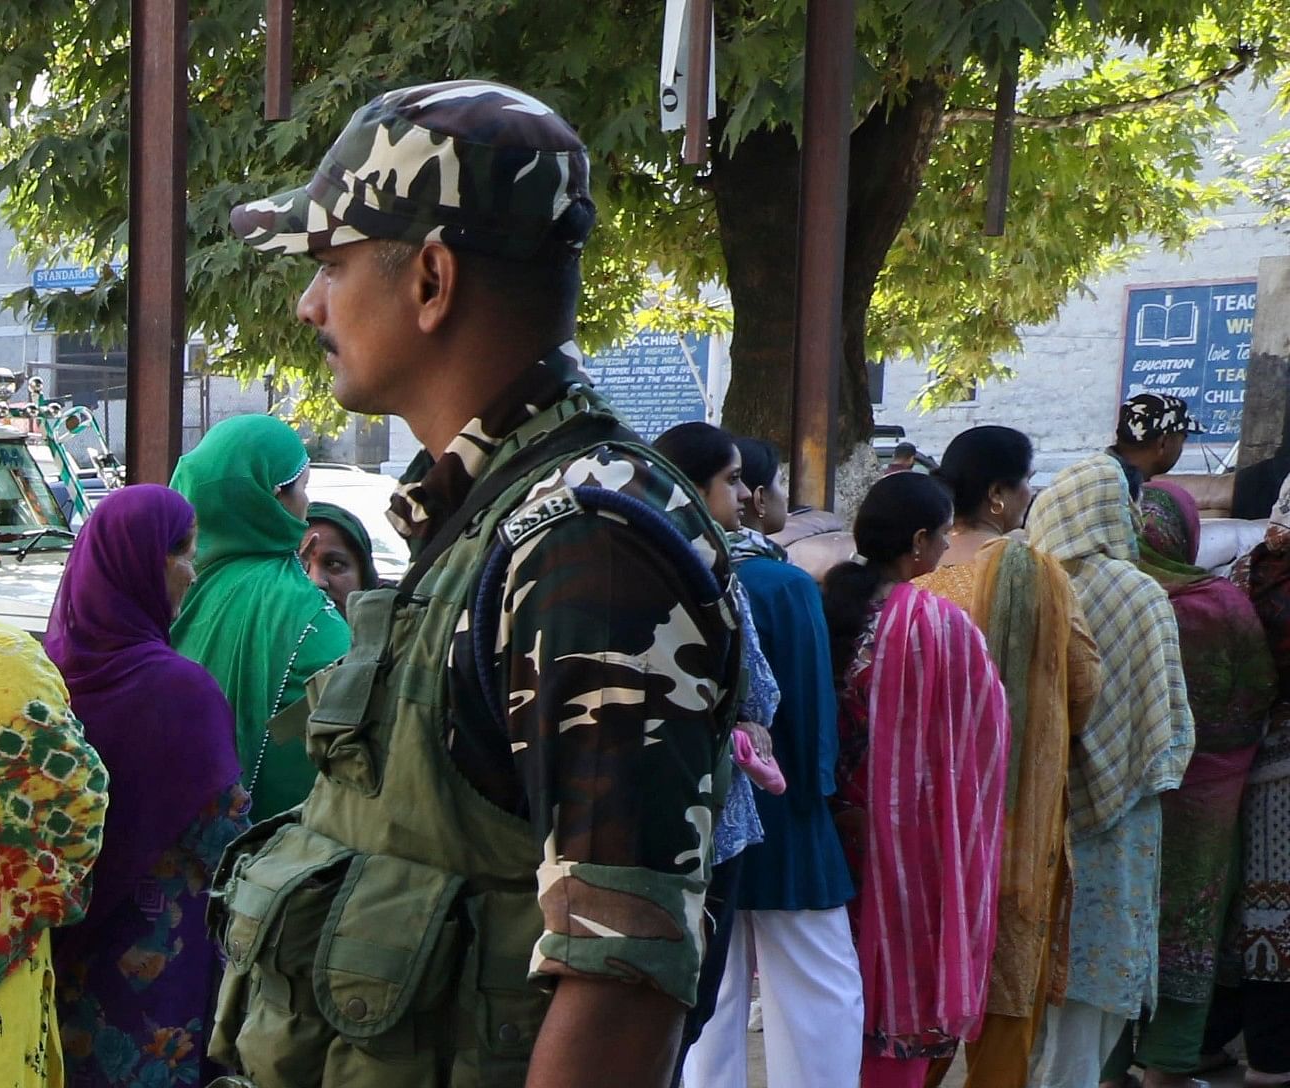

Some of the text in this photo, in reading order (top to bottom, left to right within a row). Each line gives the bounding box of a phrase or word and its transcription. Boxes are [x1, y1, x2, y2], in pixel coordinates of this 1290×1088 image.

[37, 269, 96, 282] STANDARDS
[622, 335, 679, 348] EACHING
[1131, 358, 1196, 372] EDUCATION
[1143, 372, 1181, 385] IS NOT
[508, 496, 574, 538] S.S.B.
